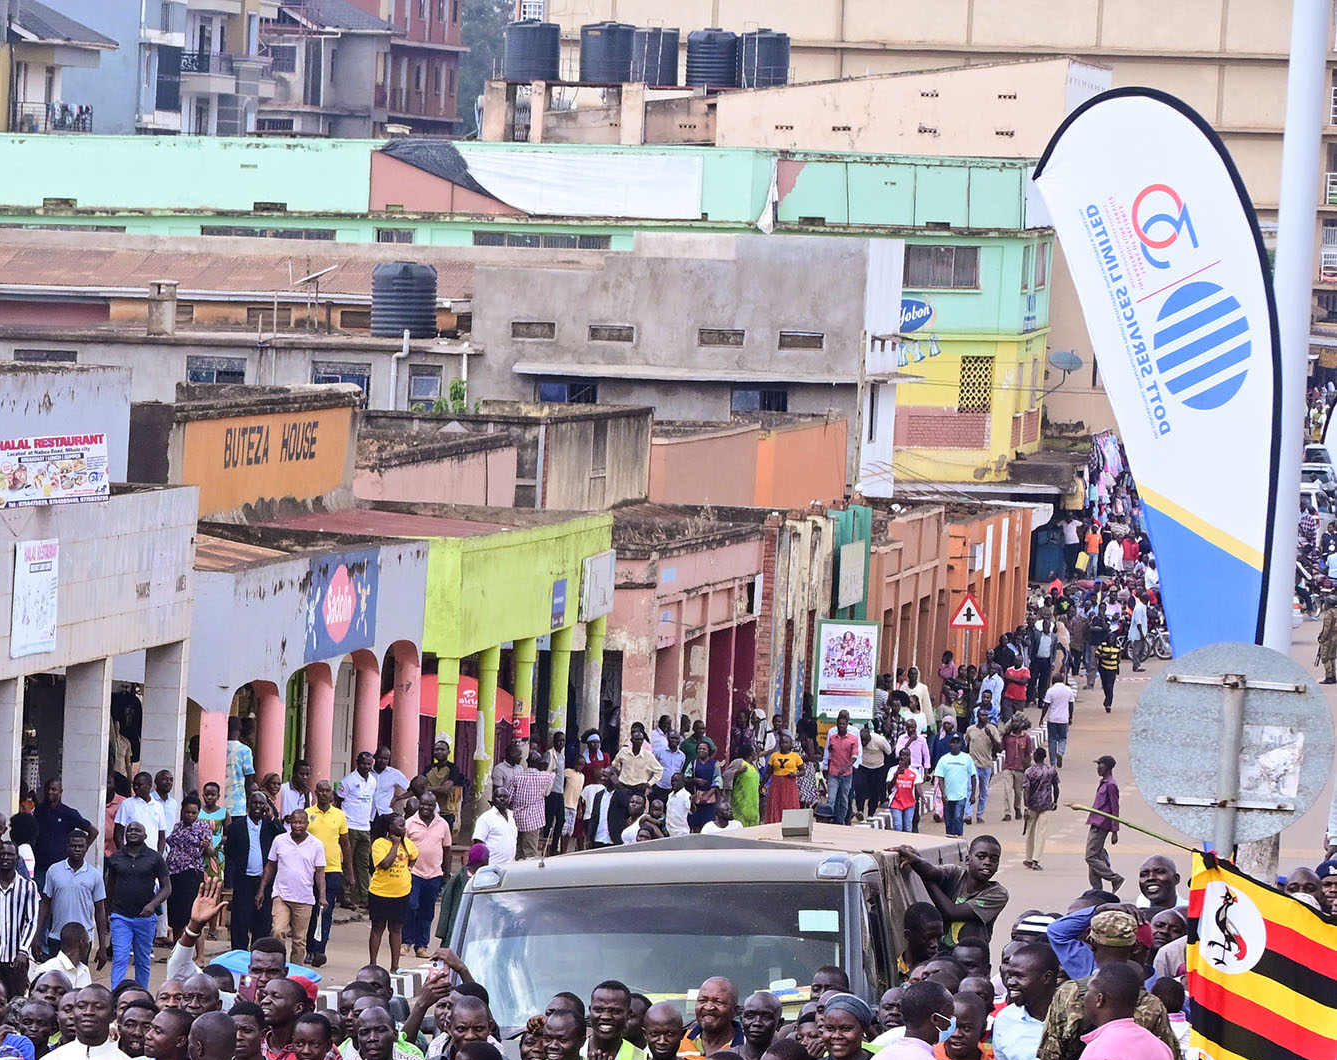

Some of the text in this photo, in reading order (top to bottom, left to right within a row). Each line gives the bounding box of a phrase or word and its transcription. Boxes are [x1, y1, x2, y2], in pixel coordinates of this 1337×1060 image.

[34, 434, 104, 448] RESTAURANT
[224, 421, 319, 469] BUTEZA HOUSE
[326, 583, 352, 625] Sadolin
[778, 759, 789, 768] Y
